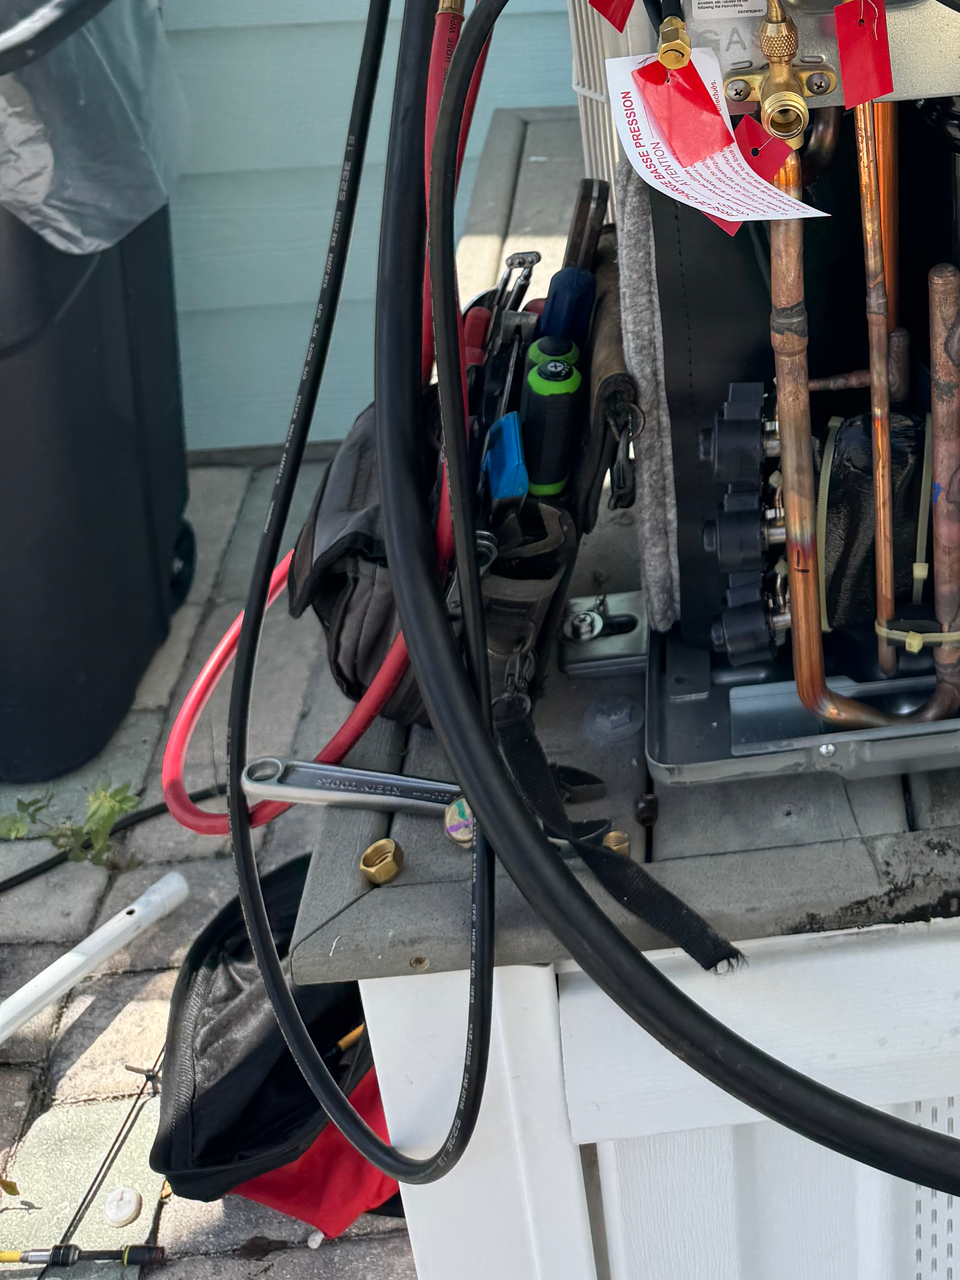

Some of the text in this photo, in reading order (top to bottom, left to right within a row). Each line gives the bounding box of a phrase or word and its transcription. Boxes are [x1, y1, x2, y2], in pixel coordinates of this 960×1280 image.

[445, 37, 454, 63] HOSE
[620, 90, 646, 149] PRESSION
[638, 150, 663, 181] BASSE
[650, 141, 690, 190] ATTENTION
[302, 366, 310, 380] CFC
[306, 342, 316, 361] HCFC
[312, 323, 320, 338] HFC
[316, 303, 324, 319] HFO
[322, 274, 331, 289] SAE
[338, 160, 353, 202] S23E
[315, 778, 357, 790] TOOLS
[445, 1117, 461, 1152] S23E
